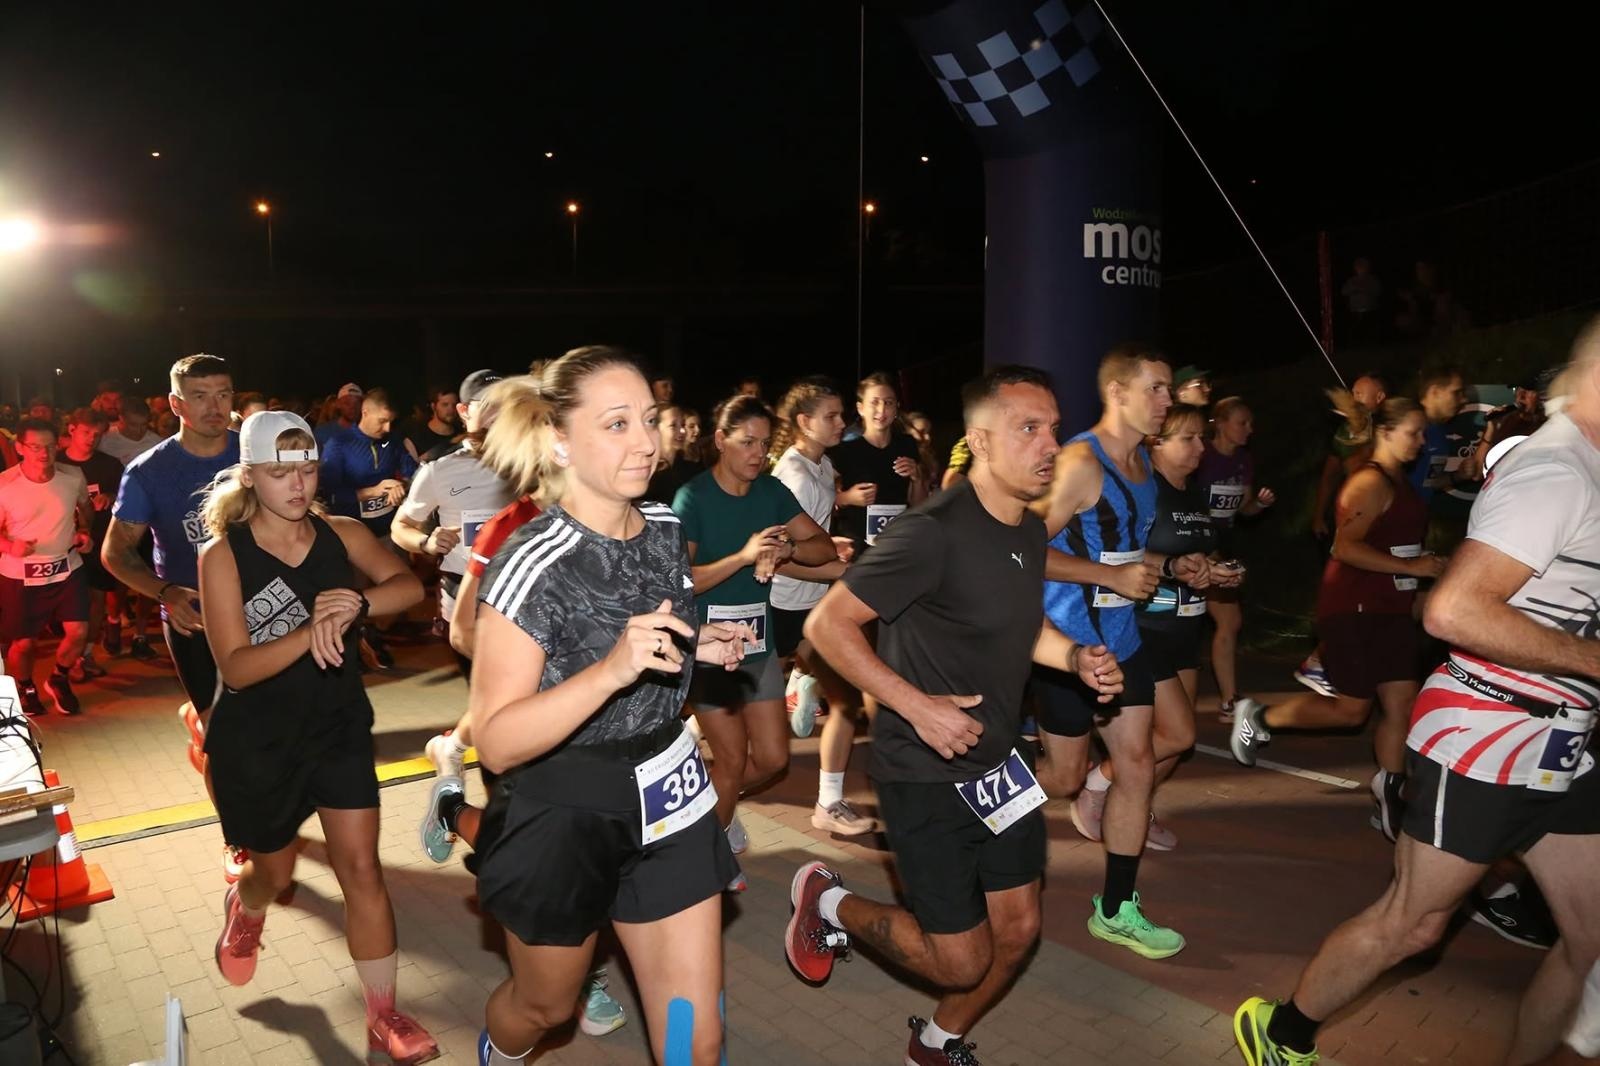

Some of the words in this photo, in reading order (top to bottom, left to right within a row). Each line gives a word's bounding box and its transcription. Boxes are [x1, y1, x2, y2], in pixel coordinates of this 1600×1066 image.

[1216, 495, 1241, 509] 310
[32, 561, 62, 577] 237
[1468, 677, 1515, 703] Kalenji
[976, 764, 1022, 809] 471
